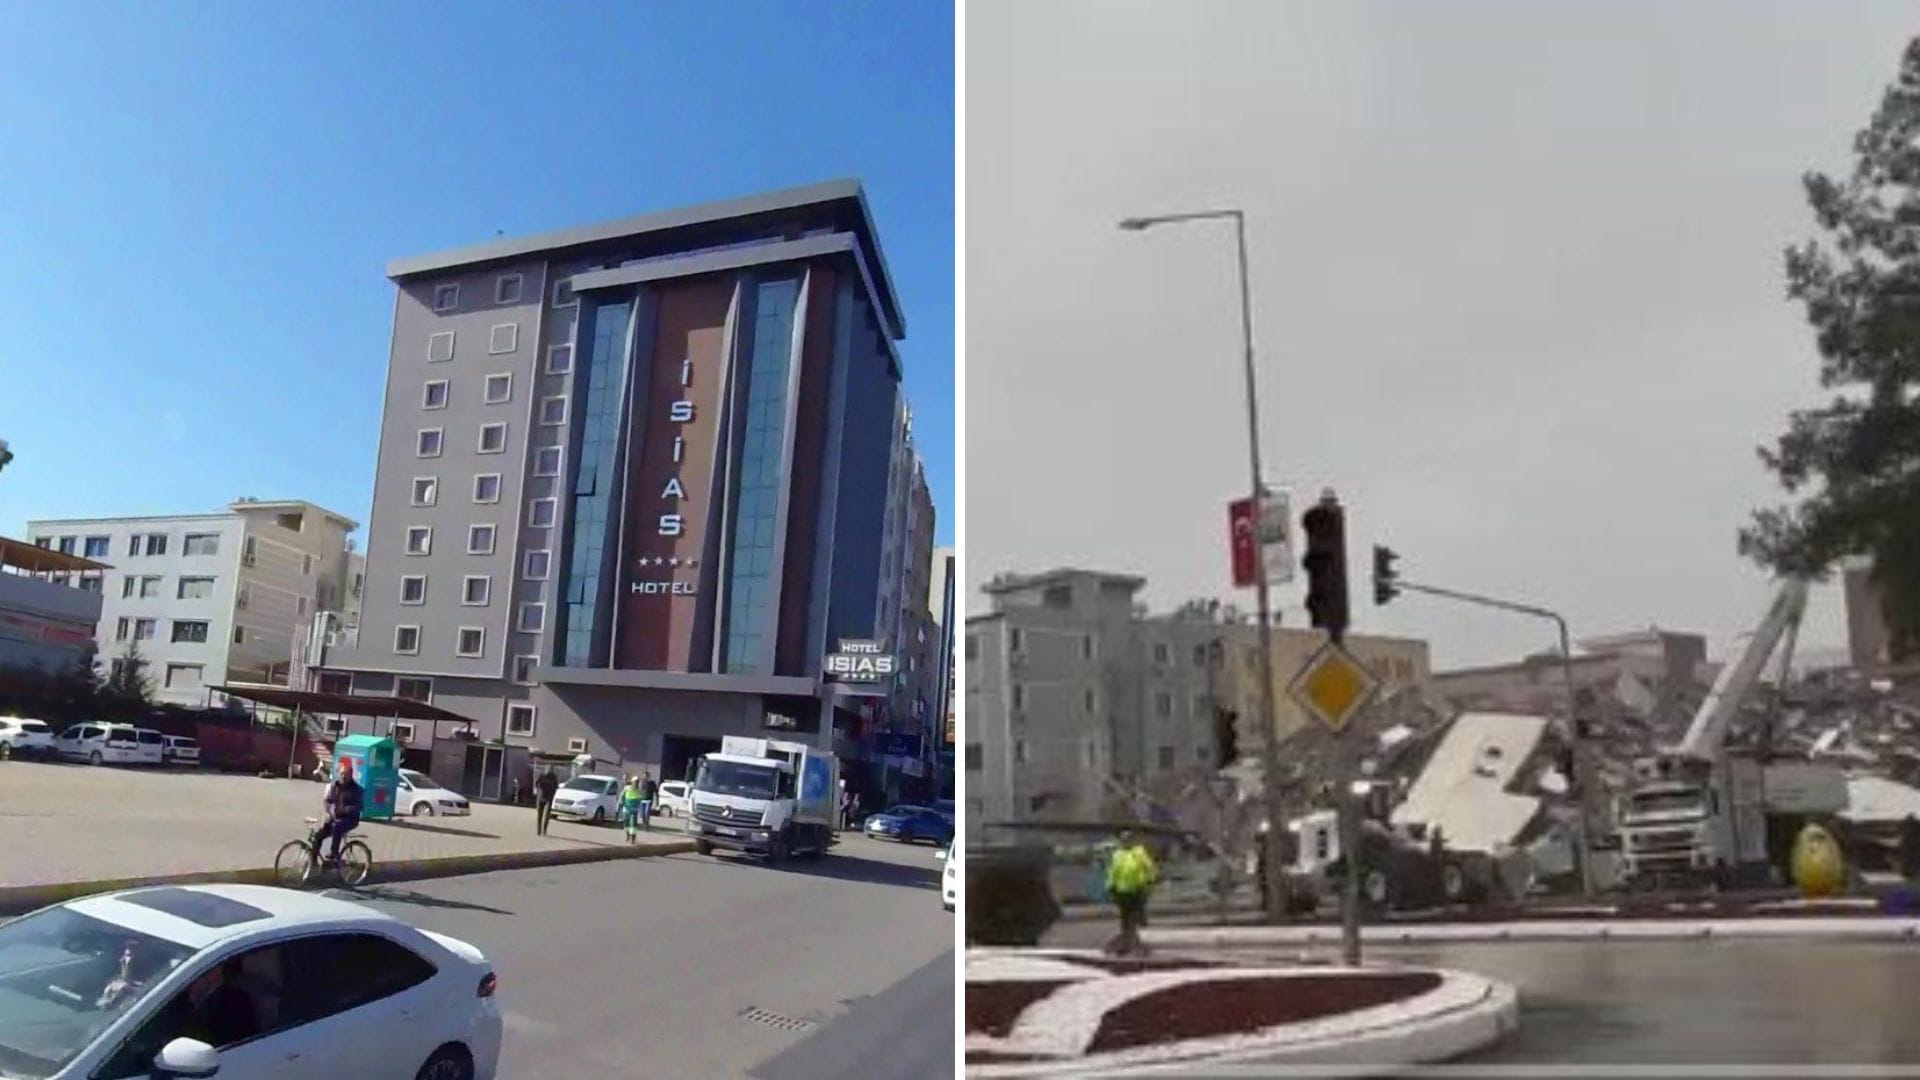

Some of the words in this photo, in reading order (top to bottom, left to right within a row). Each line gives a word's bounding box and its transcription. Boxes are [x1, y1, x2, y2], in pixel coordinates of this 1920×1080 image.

[632, 582, 695, 594] HOTEL
[842, 643, 881, 653] HOTEL
[828, 655, 892, 672] ISIAS
